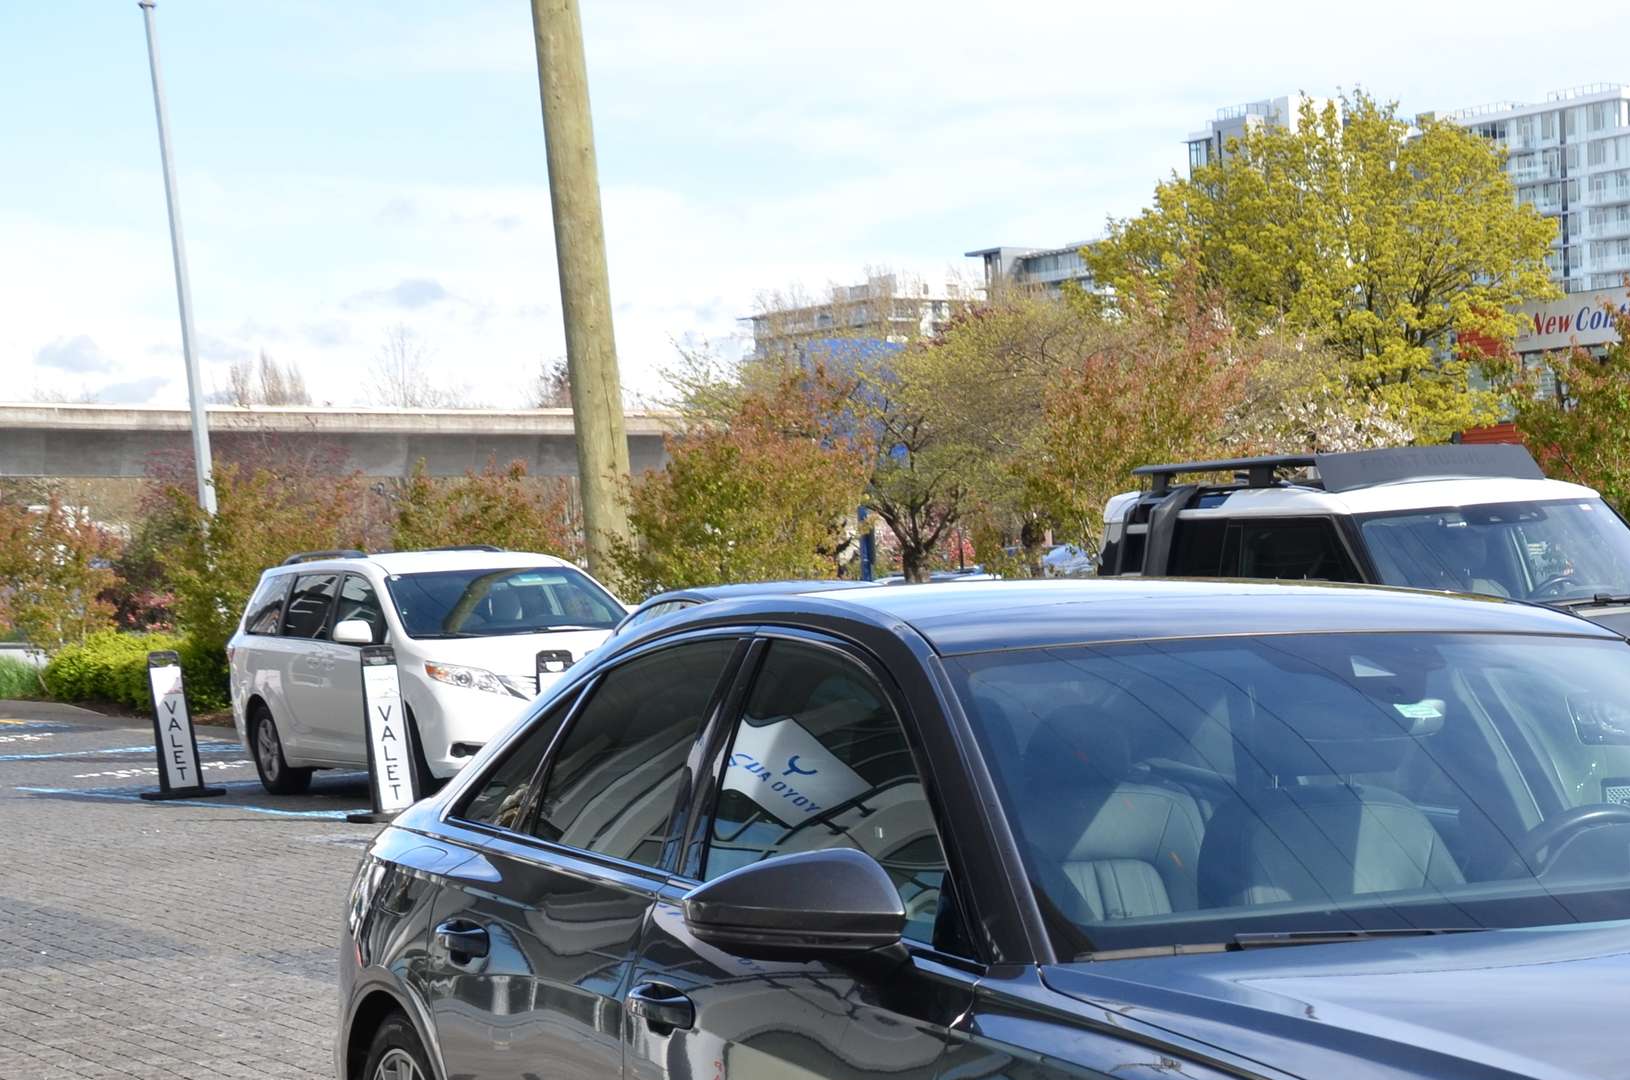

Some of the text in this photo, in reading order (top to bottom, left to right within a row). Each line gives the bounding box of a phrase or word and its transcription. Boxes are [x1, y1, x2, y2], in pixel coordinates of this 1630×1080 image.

[1533, 311, 1574, 336] New
[164, 700, 188, 780] VALET
[378, 704, 401, 801] VALET
